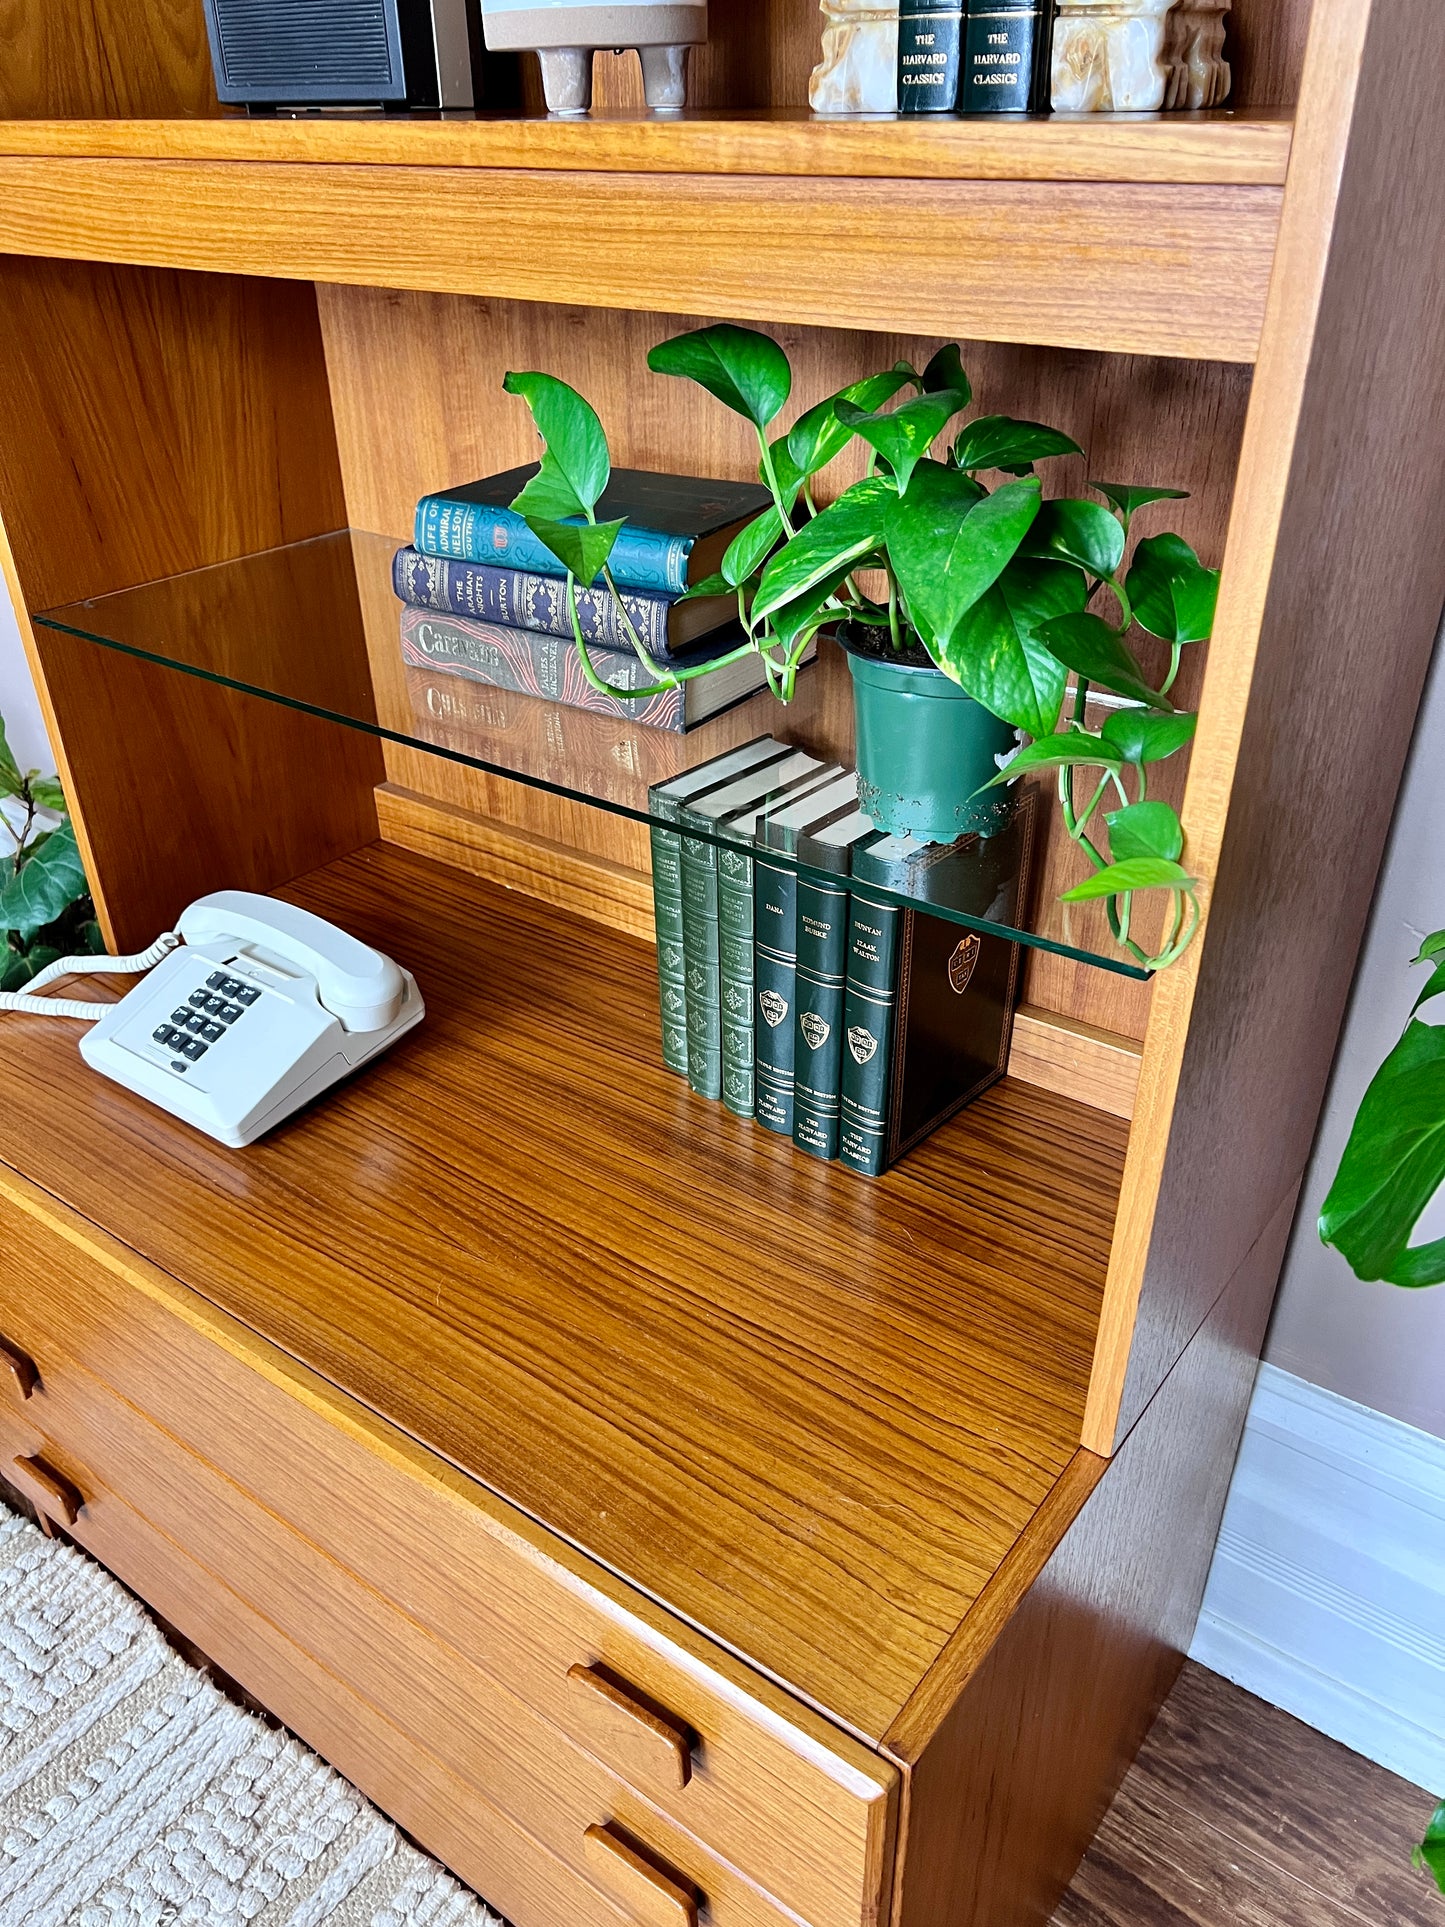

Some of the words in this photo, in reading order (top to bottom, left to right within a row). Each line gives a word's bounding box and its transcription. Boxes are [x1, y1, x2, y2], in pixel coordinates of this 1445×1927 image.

[914, 33, 935, 45] THE
[987, 33, 1008, 44] THE
[902, 53, 948, 65] HARVARD
[974, 52, 1020, 65] HARVARD
[902, 72, 945, 84] CLASSICS
[974, 73, 1018, 85] CLASSICS
[429, 502, 440, 518] OF
[440, 506, 452, 553] ADMIRAL
[452, 507, 465, 554] NELSON
[466, 508, 476, 557] SOUTHEY
[427, 524, 437, 552] LIFE
[456, 580, 464, 602] THE
[466, 570, 477, 614] ARABIAN
[476, 576, 485, 614] NIGHTS
[499, 578, 510, 621] BURTON
[419, 624, 499, 667] Caravans
[540, 657, 550, 690] JAMES
[765, 903, 784, 915] DANA
[802, 916, 831, 930] EDMUND
[854, 921, 882, 936] BUNYAN
[805, 926, 828, 939] BURKE
[856, 939, 877, 952] IZAAK
[853, 947, 880, 962] WALTON
[759, 1098, 786, 1115] HARVARD
[765, 1094, 778, 1104] THE
[759, 1108, 785, 1124] CLASSICS
[806, 1118, 819, 1127] THE
[798, 1122, 828, 1139] HARVARD
[849, 1132, 864, 1142] THE
[798, 1132, 826, 1148] CLASSICS
[842, 1136, 871, 1154] HARVARD
[842, 1147, 870, 1164] CLASSICS
